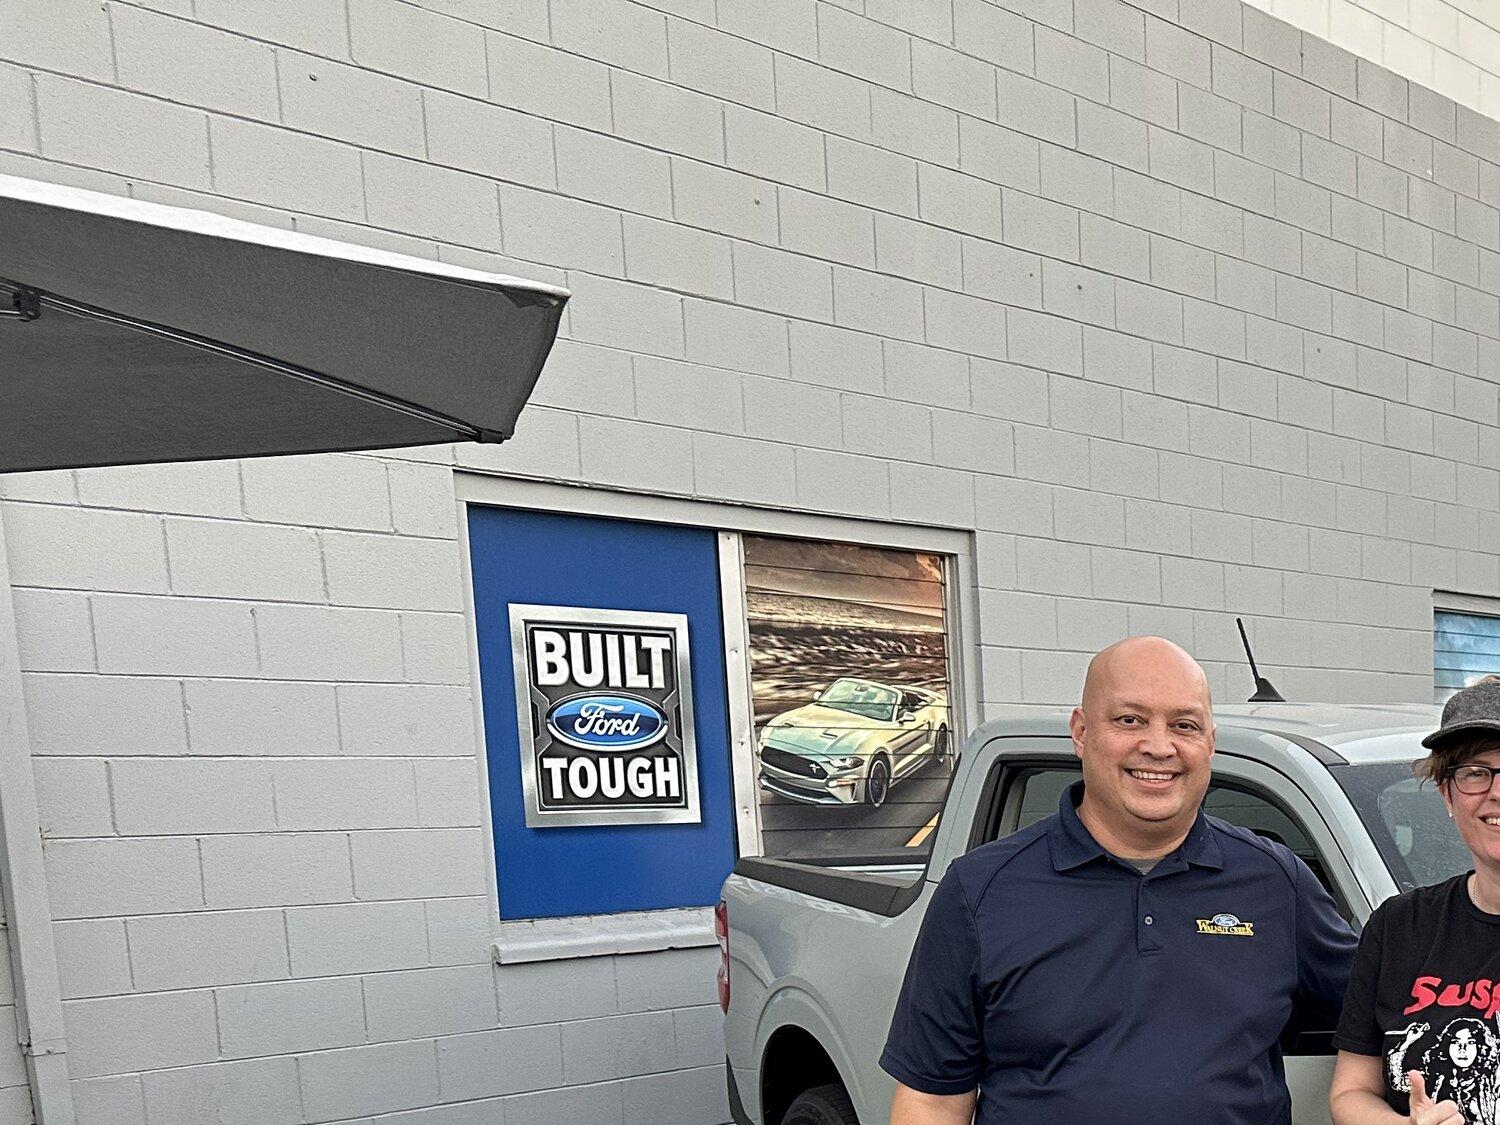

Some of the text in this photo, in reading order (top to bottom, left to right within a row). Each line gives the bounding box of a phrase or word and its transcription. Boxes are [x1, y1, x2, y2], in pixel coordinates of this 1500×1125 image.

[533, 629, 672, 689] BUILT
[574, 702, 641, 736] Ford
[542, 756, 681, 800] TOUGH
